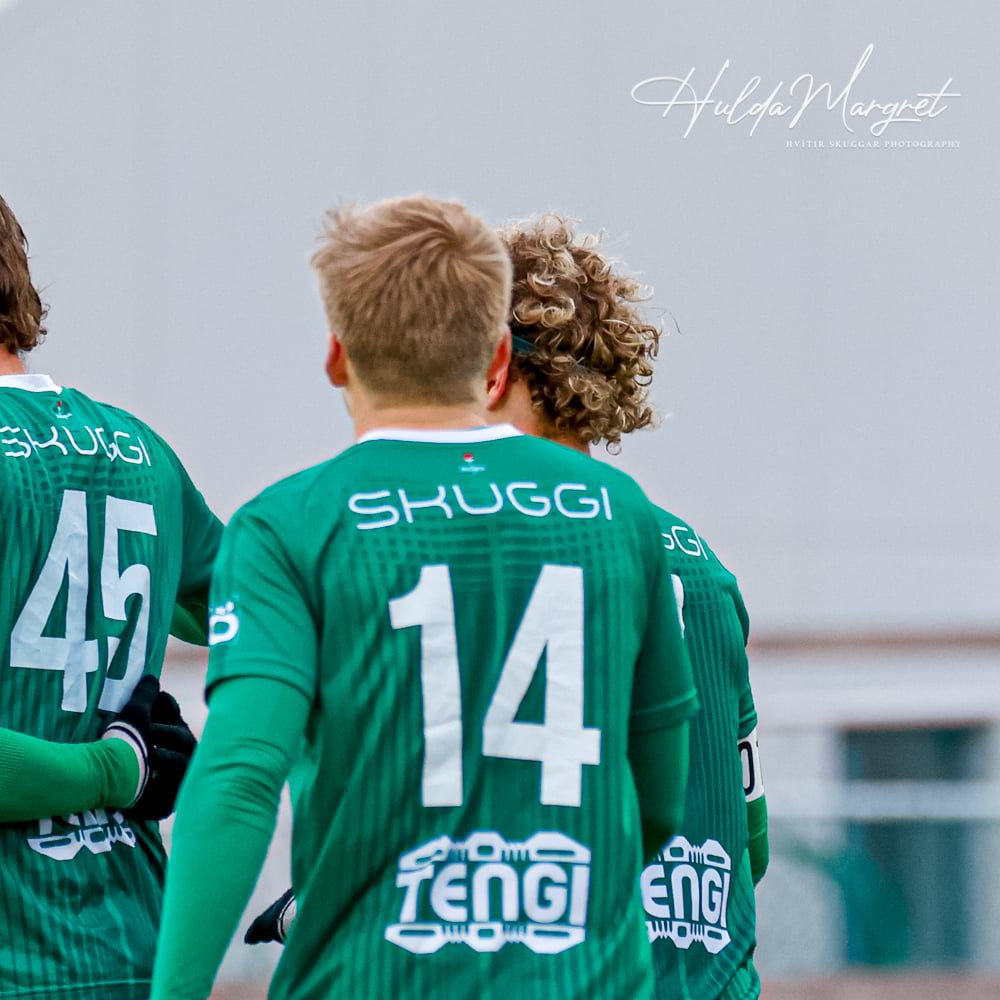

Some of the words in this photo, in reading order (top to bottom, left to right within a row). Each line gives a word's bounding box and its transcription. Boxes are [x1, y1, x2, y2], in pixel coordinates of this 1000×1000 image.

[348, 482, 613, 530] SKUGGI
[9, 489, 158, 713] 45
[388, 563, 601, 807] 14
[396, 863, 591, 924] TENGI
[639, 863, 731, 928] ENGI
